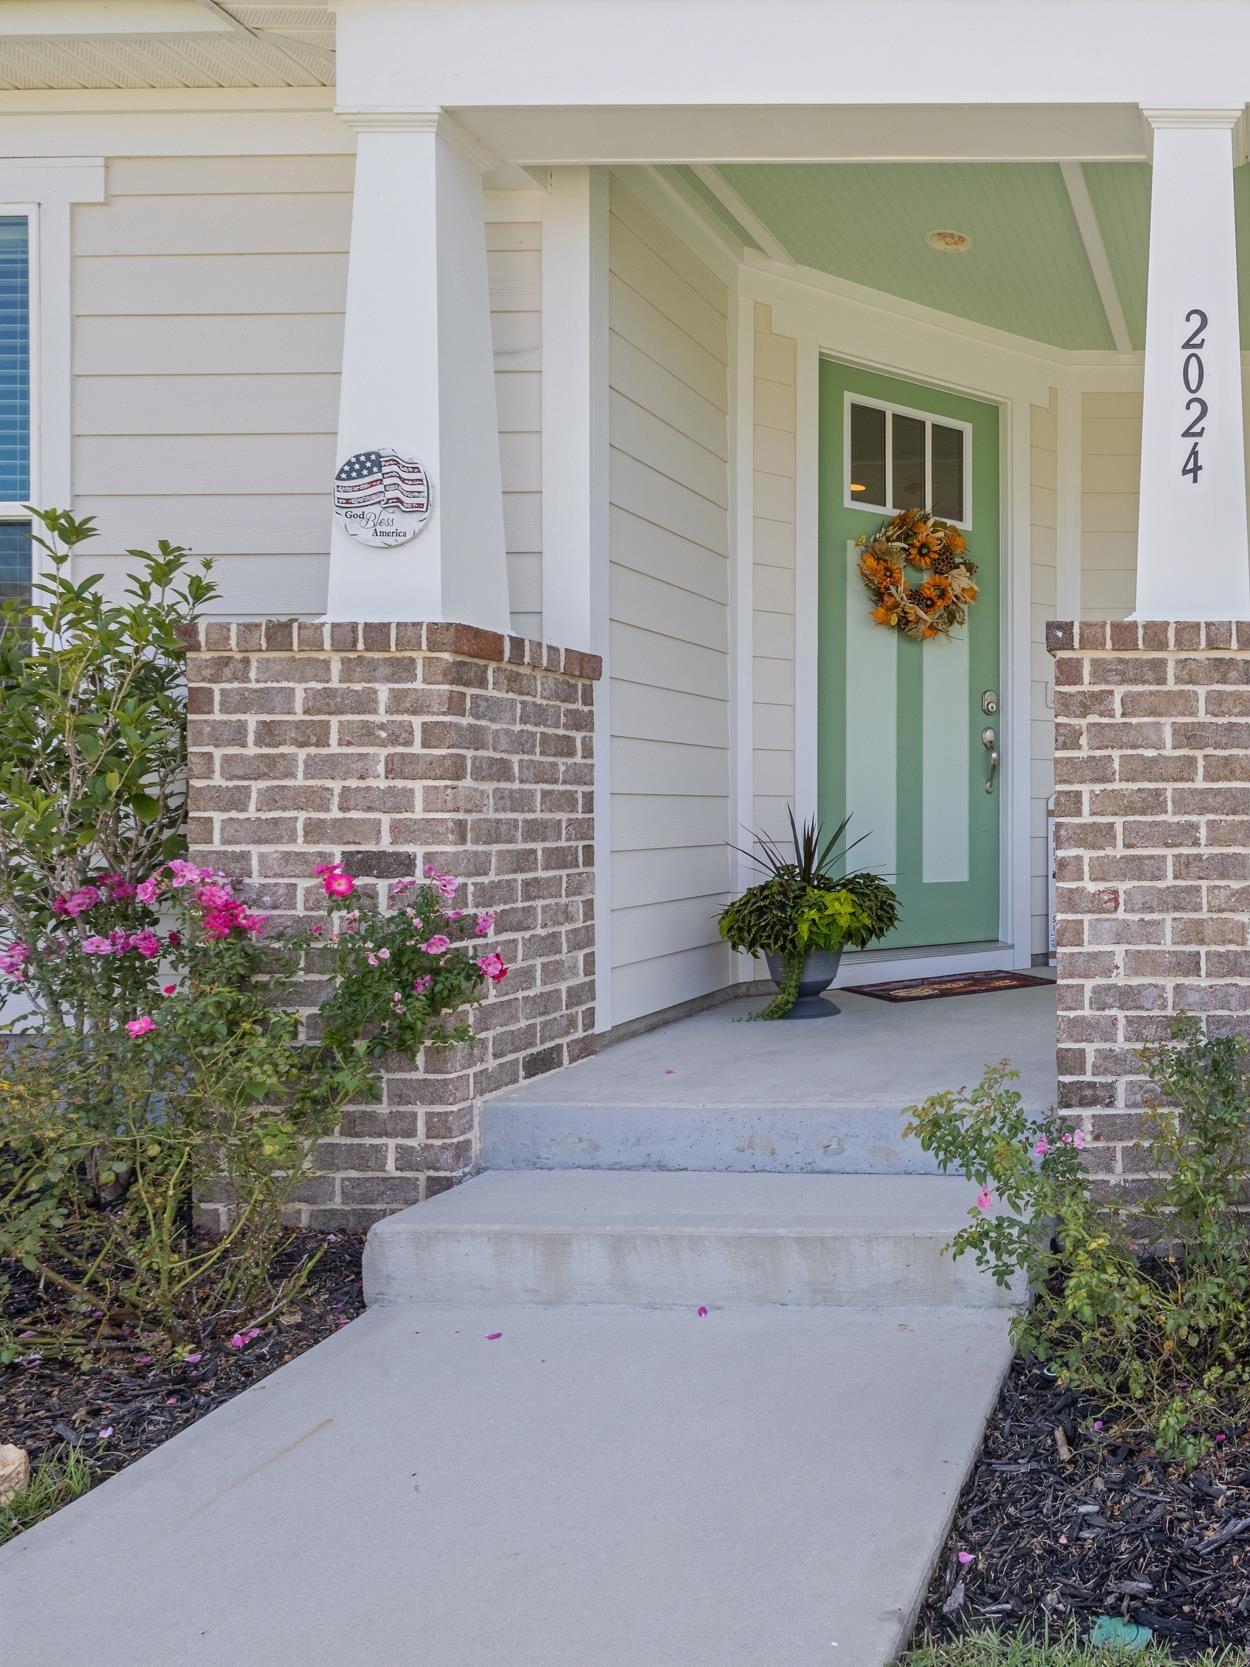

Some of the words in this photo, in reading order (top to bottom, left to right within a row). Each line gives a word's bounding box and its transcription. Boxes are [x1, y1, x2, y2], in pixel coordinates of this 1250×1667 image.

[1181, 309, 1208, 484] 2024
[344, 510, 365, 519] God
[360, 509, 395, 530] Bless
[372, 528, 407, 538] America
